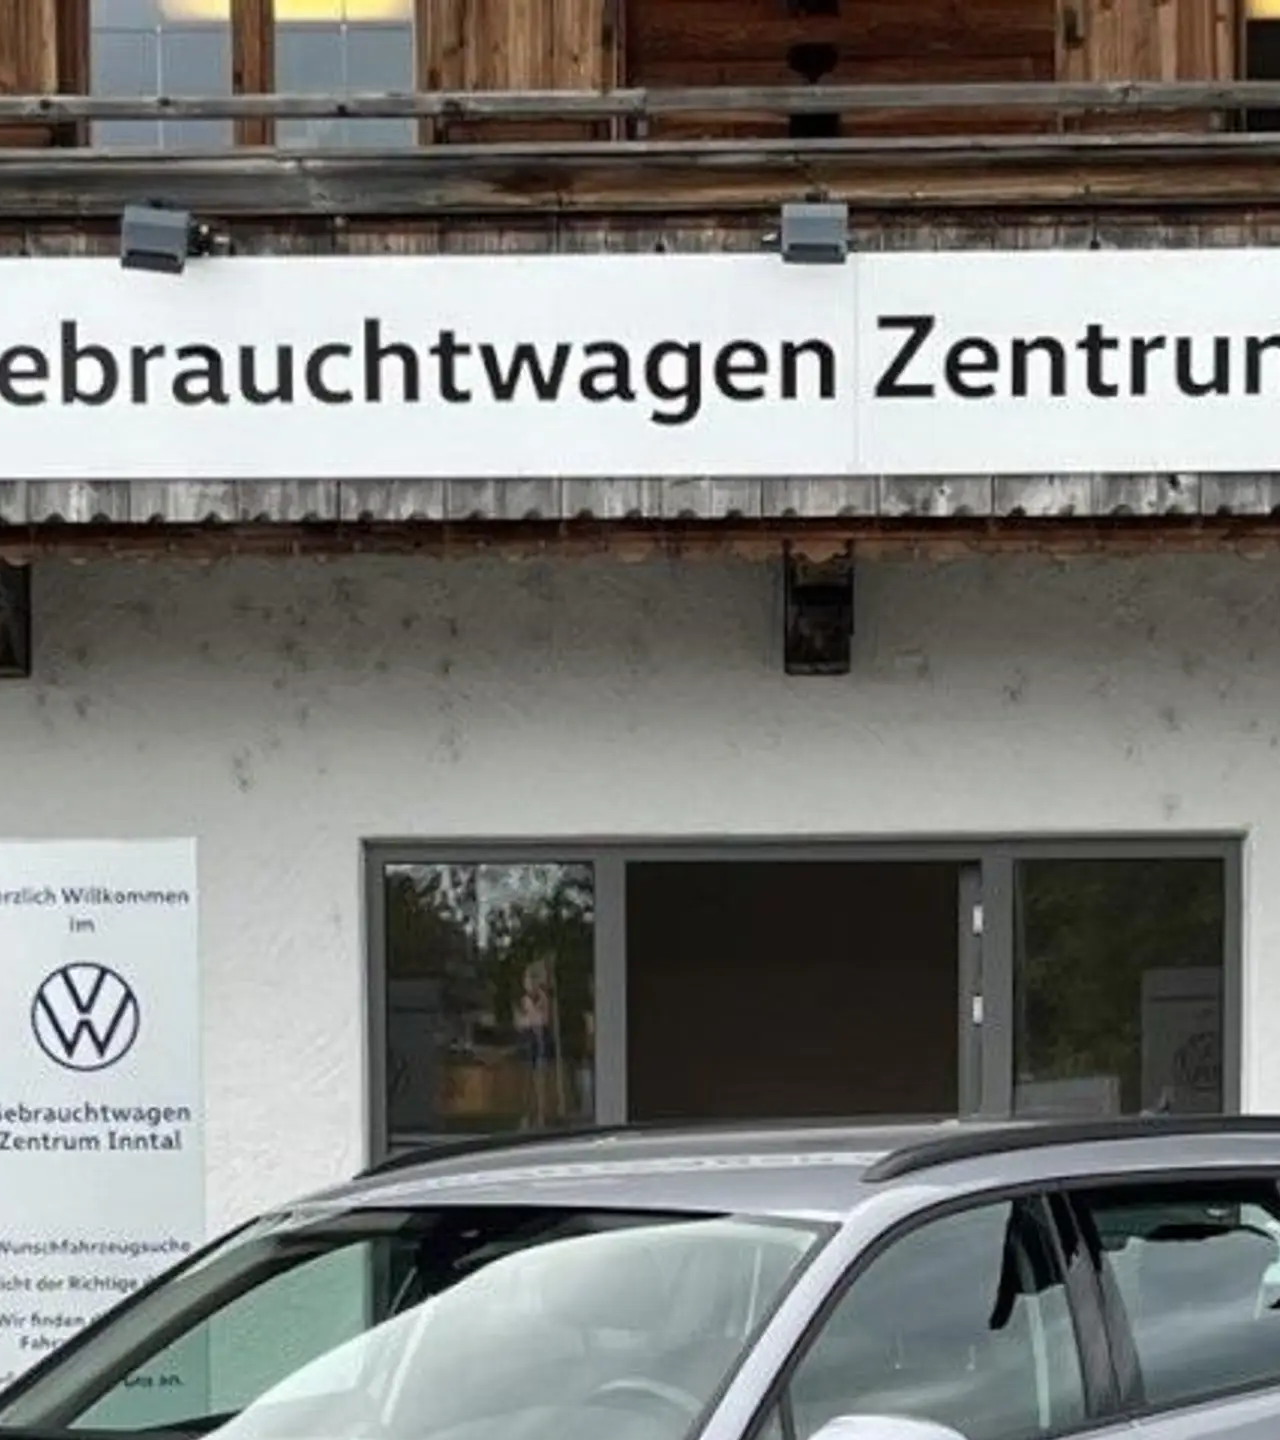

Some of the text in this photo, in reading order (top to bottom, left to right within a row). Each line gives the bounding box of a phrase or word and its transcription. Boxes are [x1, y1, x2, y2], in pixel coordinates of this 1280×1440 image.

[61, 887, 190, 905] Willkommen
[70, 917, 96, 933] im
[108, 1129, 182, 1150] Inntal
[67, 1276, 138, 1294] Richtige
[30, 1312, 85, 1328] finden
